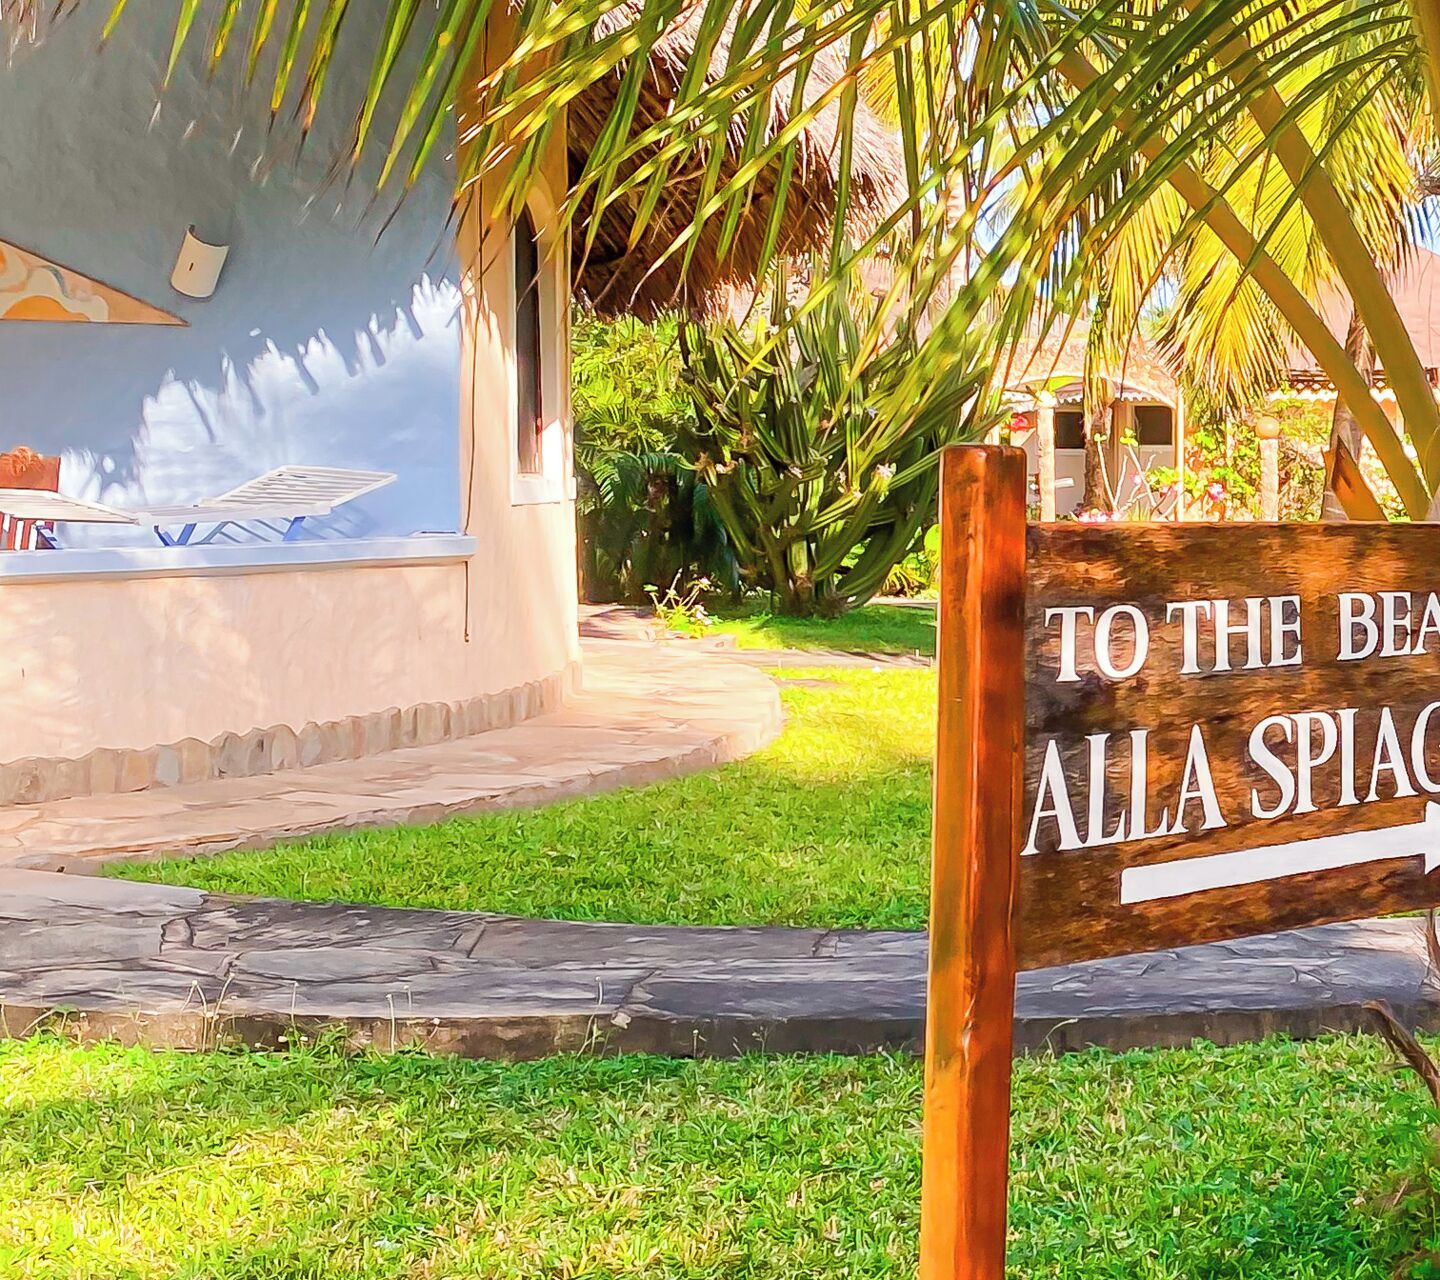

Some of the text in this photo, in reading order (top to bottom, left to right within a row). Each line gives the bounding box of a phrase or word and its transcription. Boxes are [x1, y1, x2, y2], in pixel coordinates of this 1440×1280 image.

[1045, 605, 1150, 682] TO
[1165, 595, 1303, 674] THE
[1020, 724, 1228, 856] ALLA
